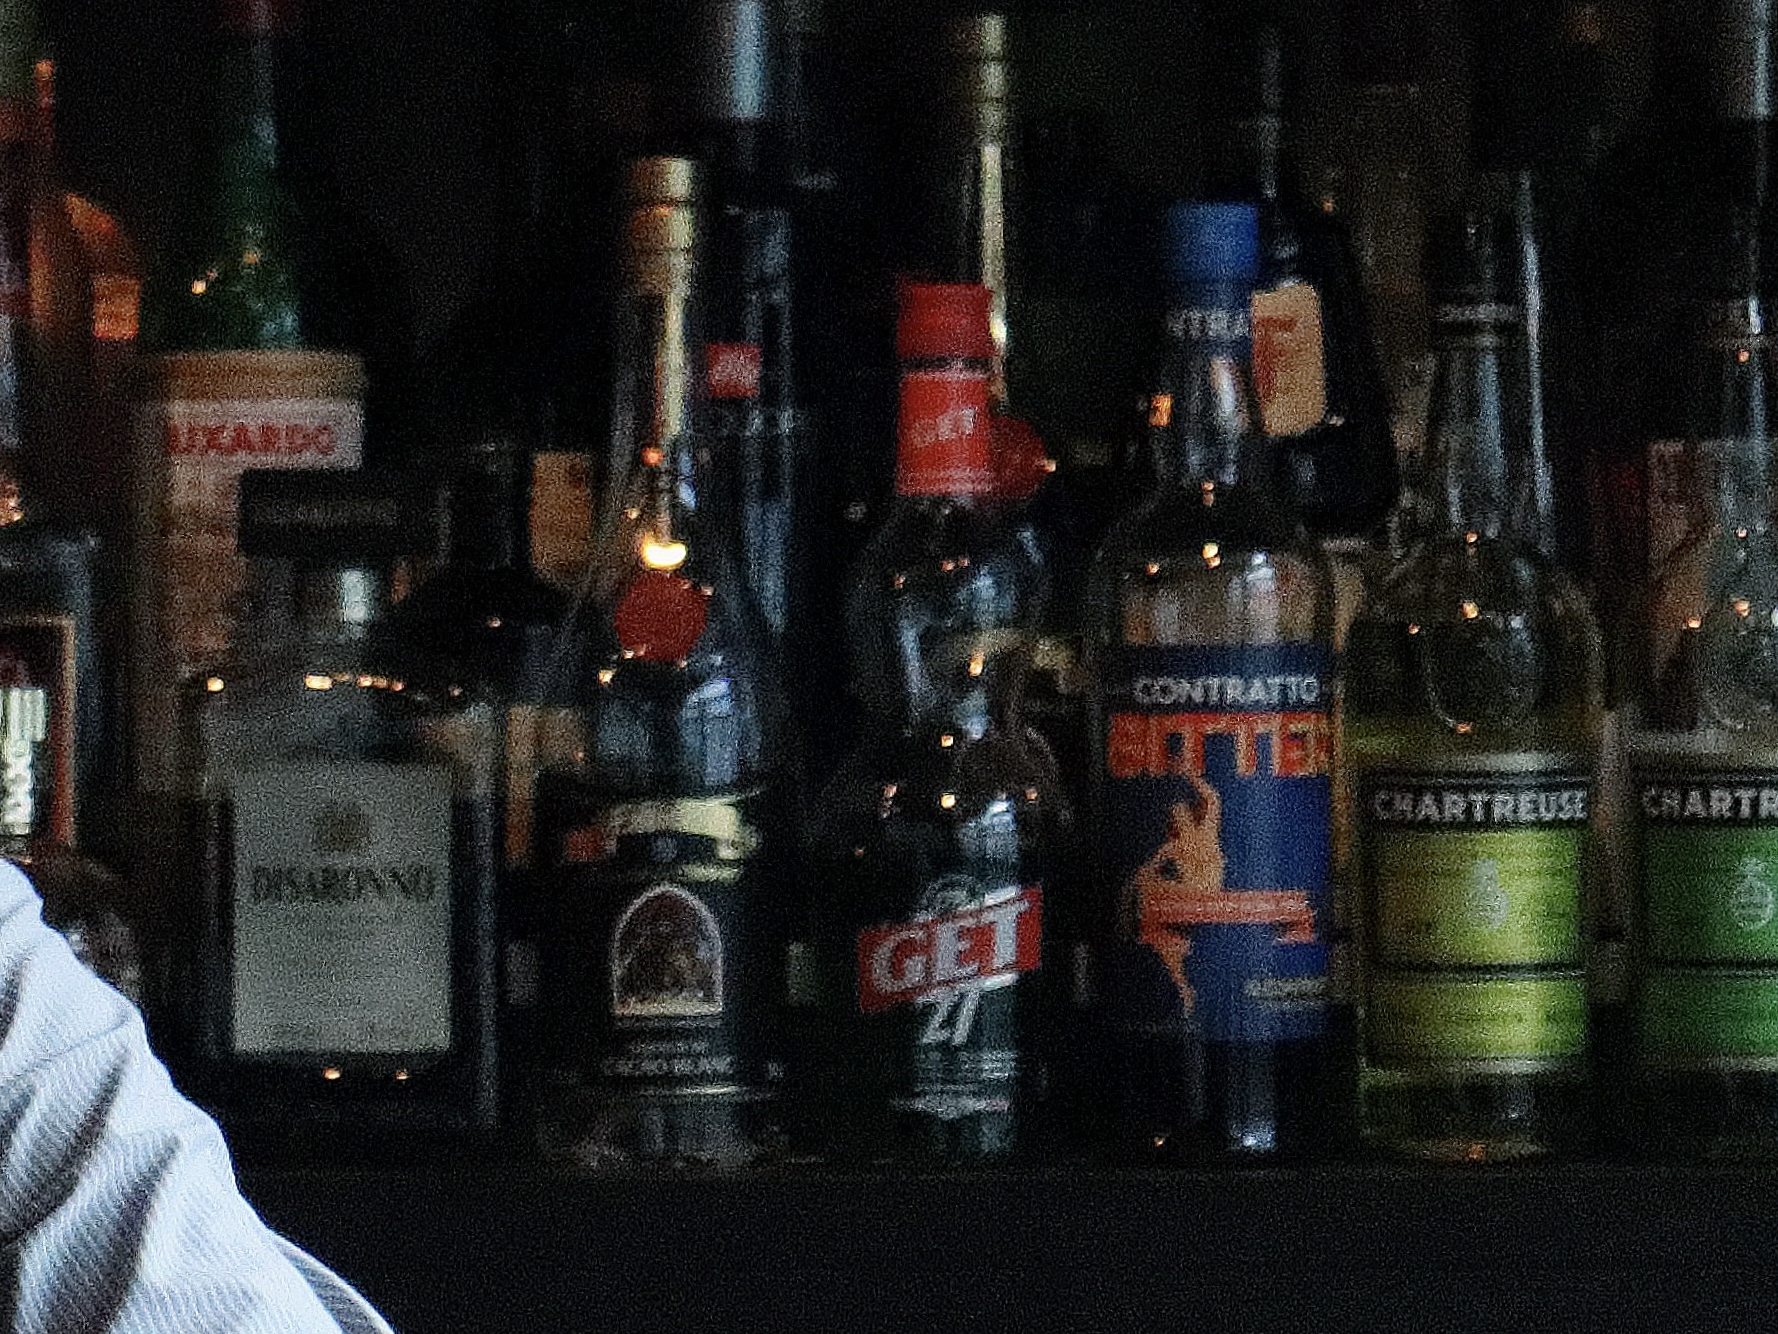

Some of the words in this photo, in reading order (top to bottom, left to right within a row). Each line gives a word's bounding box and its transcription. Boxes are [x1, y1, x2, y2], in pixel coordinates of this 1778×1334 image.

[1134, 675, 1320, 705] CONTRATTO
[1373, 788, 1587, 824] CHARTREUSE
[251, 867, 436, 906] DISARONNO
[872, 900, 1031, 995] GET
[917, 987, 980, 1046] 27
